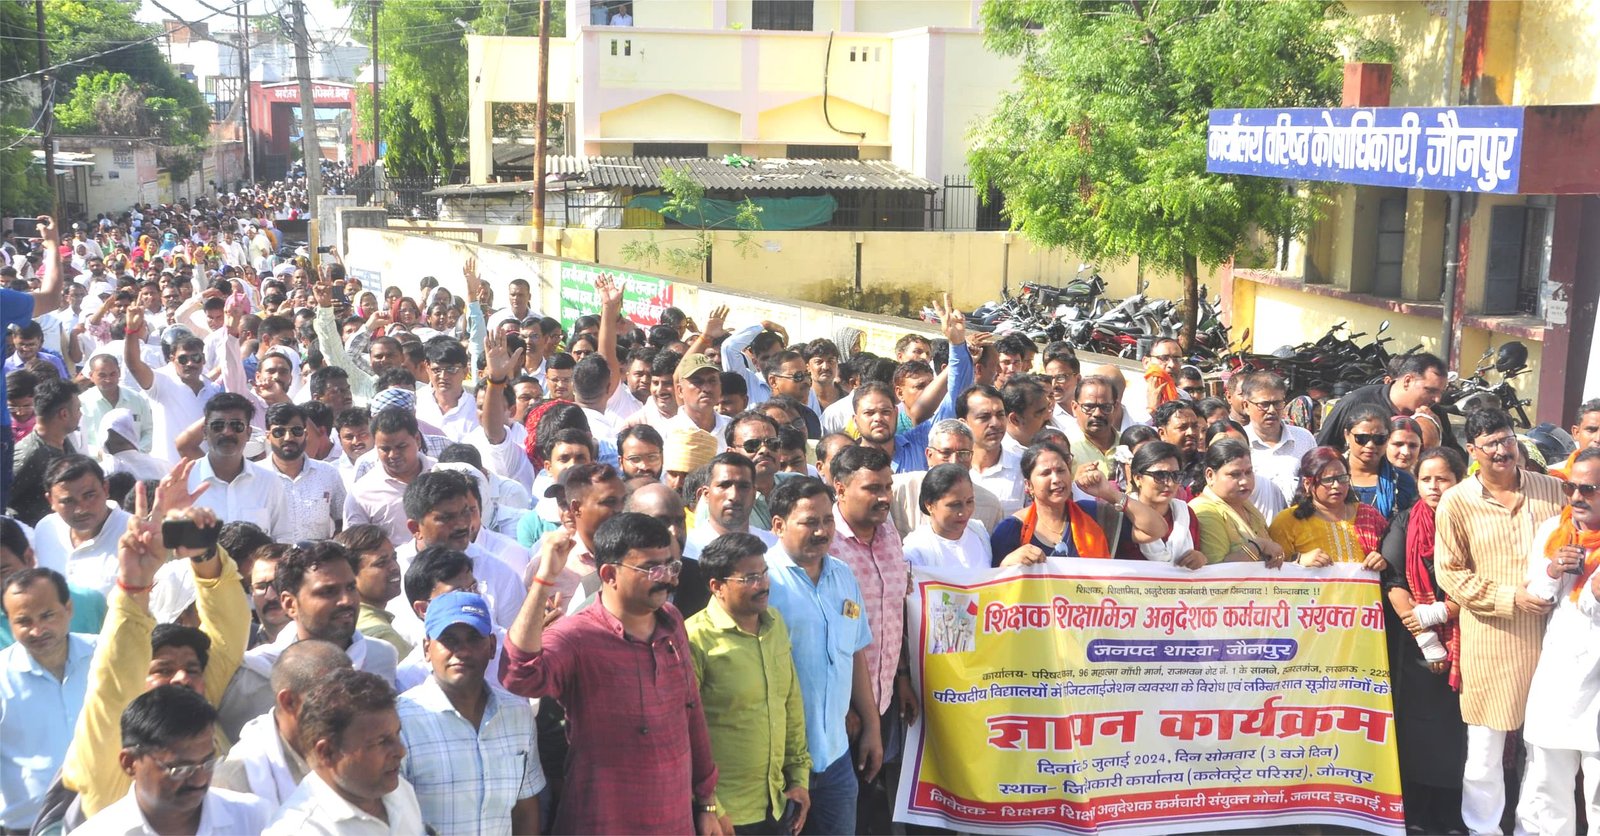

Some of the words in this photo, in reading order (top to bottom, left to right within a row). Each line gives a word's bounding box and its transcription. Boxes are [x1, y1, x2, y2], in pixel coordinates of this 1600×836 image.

[1208, 113, 1264, 163] कार्यालय
[1265, 113, 1312, 165] वरिष्ठ
[1425, 110, 1518, 191] जौनपुर
[984, 602, 1051, 633] शिक्षक
[1053, 596, 1138, 629] शिक्षामित्र
[1143, 600, 1218, 635] अनुदेशक
[1223, 599, 1290, 628] कर्मचारी
[1297, 599, 1357, 632] संयुक्त
[1361, 602, 1384, 629] मो
[1094, 645, 1158, 656] जनपद
[1226, 640, 1292, 659] जौनपुर
[1078, 668, 1089, 677] 96
[1167, 668, 1202, 676] राजभवन
[934, 686, 987, 703] परिषदीय
[990, 682, 1048, 698] विद्यालयों
[1051, 682, 1062, 698] में
[1063, 679, 1135, 697] जिटलाईजेशन
[1138, 682, 1179, 693] व्यवस्था
[1181, 679, 1194, 692] के
[1196, 678, 1225, 693] विरोध
[1228, 679, 1241, 693] एवं
[1244, 678, 1280, 692] लम्बित
[1281, 679, 1303, 690] सात
[1305, 676, 1337, 694] सूत्रीय
[1339, 676, 1372, 692] मांगों
[1374, 680, 1388, 694] के
[987, 709, 1143, 750] ज्ञापन
[1159, 695, 1393, 742] कार्यक्रम
[1091, 751, 1131, 772] जुलाई
[1175, 748, 1202, 762] दिन
[1205, 748, 1257, 762] सोमवार
[1280, 745, 1305, 759] बजे
[1309, 744, 1339, 761] दिन)
[1126, 770, 1184, 785] कार्यालय
[1317, 763, 1374, 784] जौनपुर
[1001, 806, 1056, 817] शिक्षक
[1097, 799, 1153, 817] अनुदेशक
[1155, 793, 1206, 810] कर्मचारी
[1208, 792, 1251, 809] संयुक्त
[1291, 791, 1332, 801] जनपद
